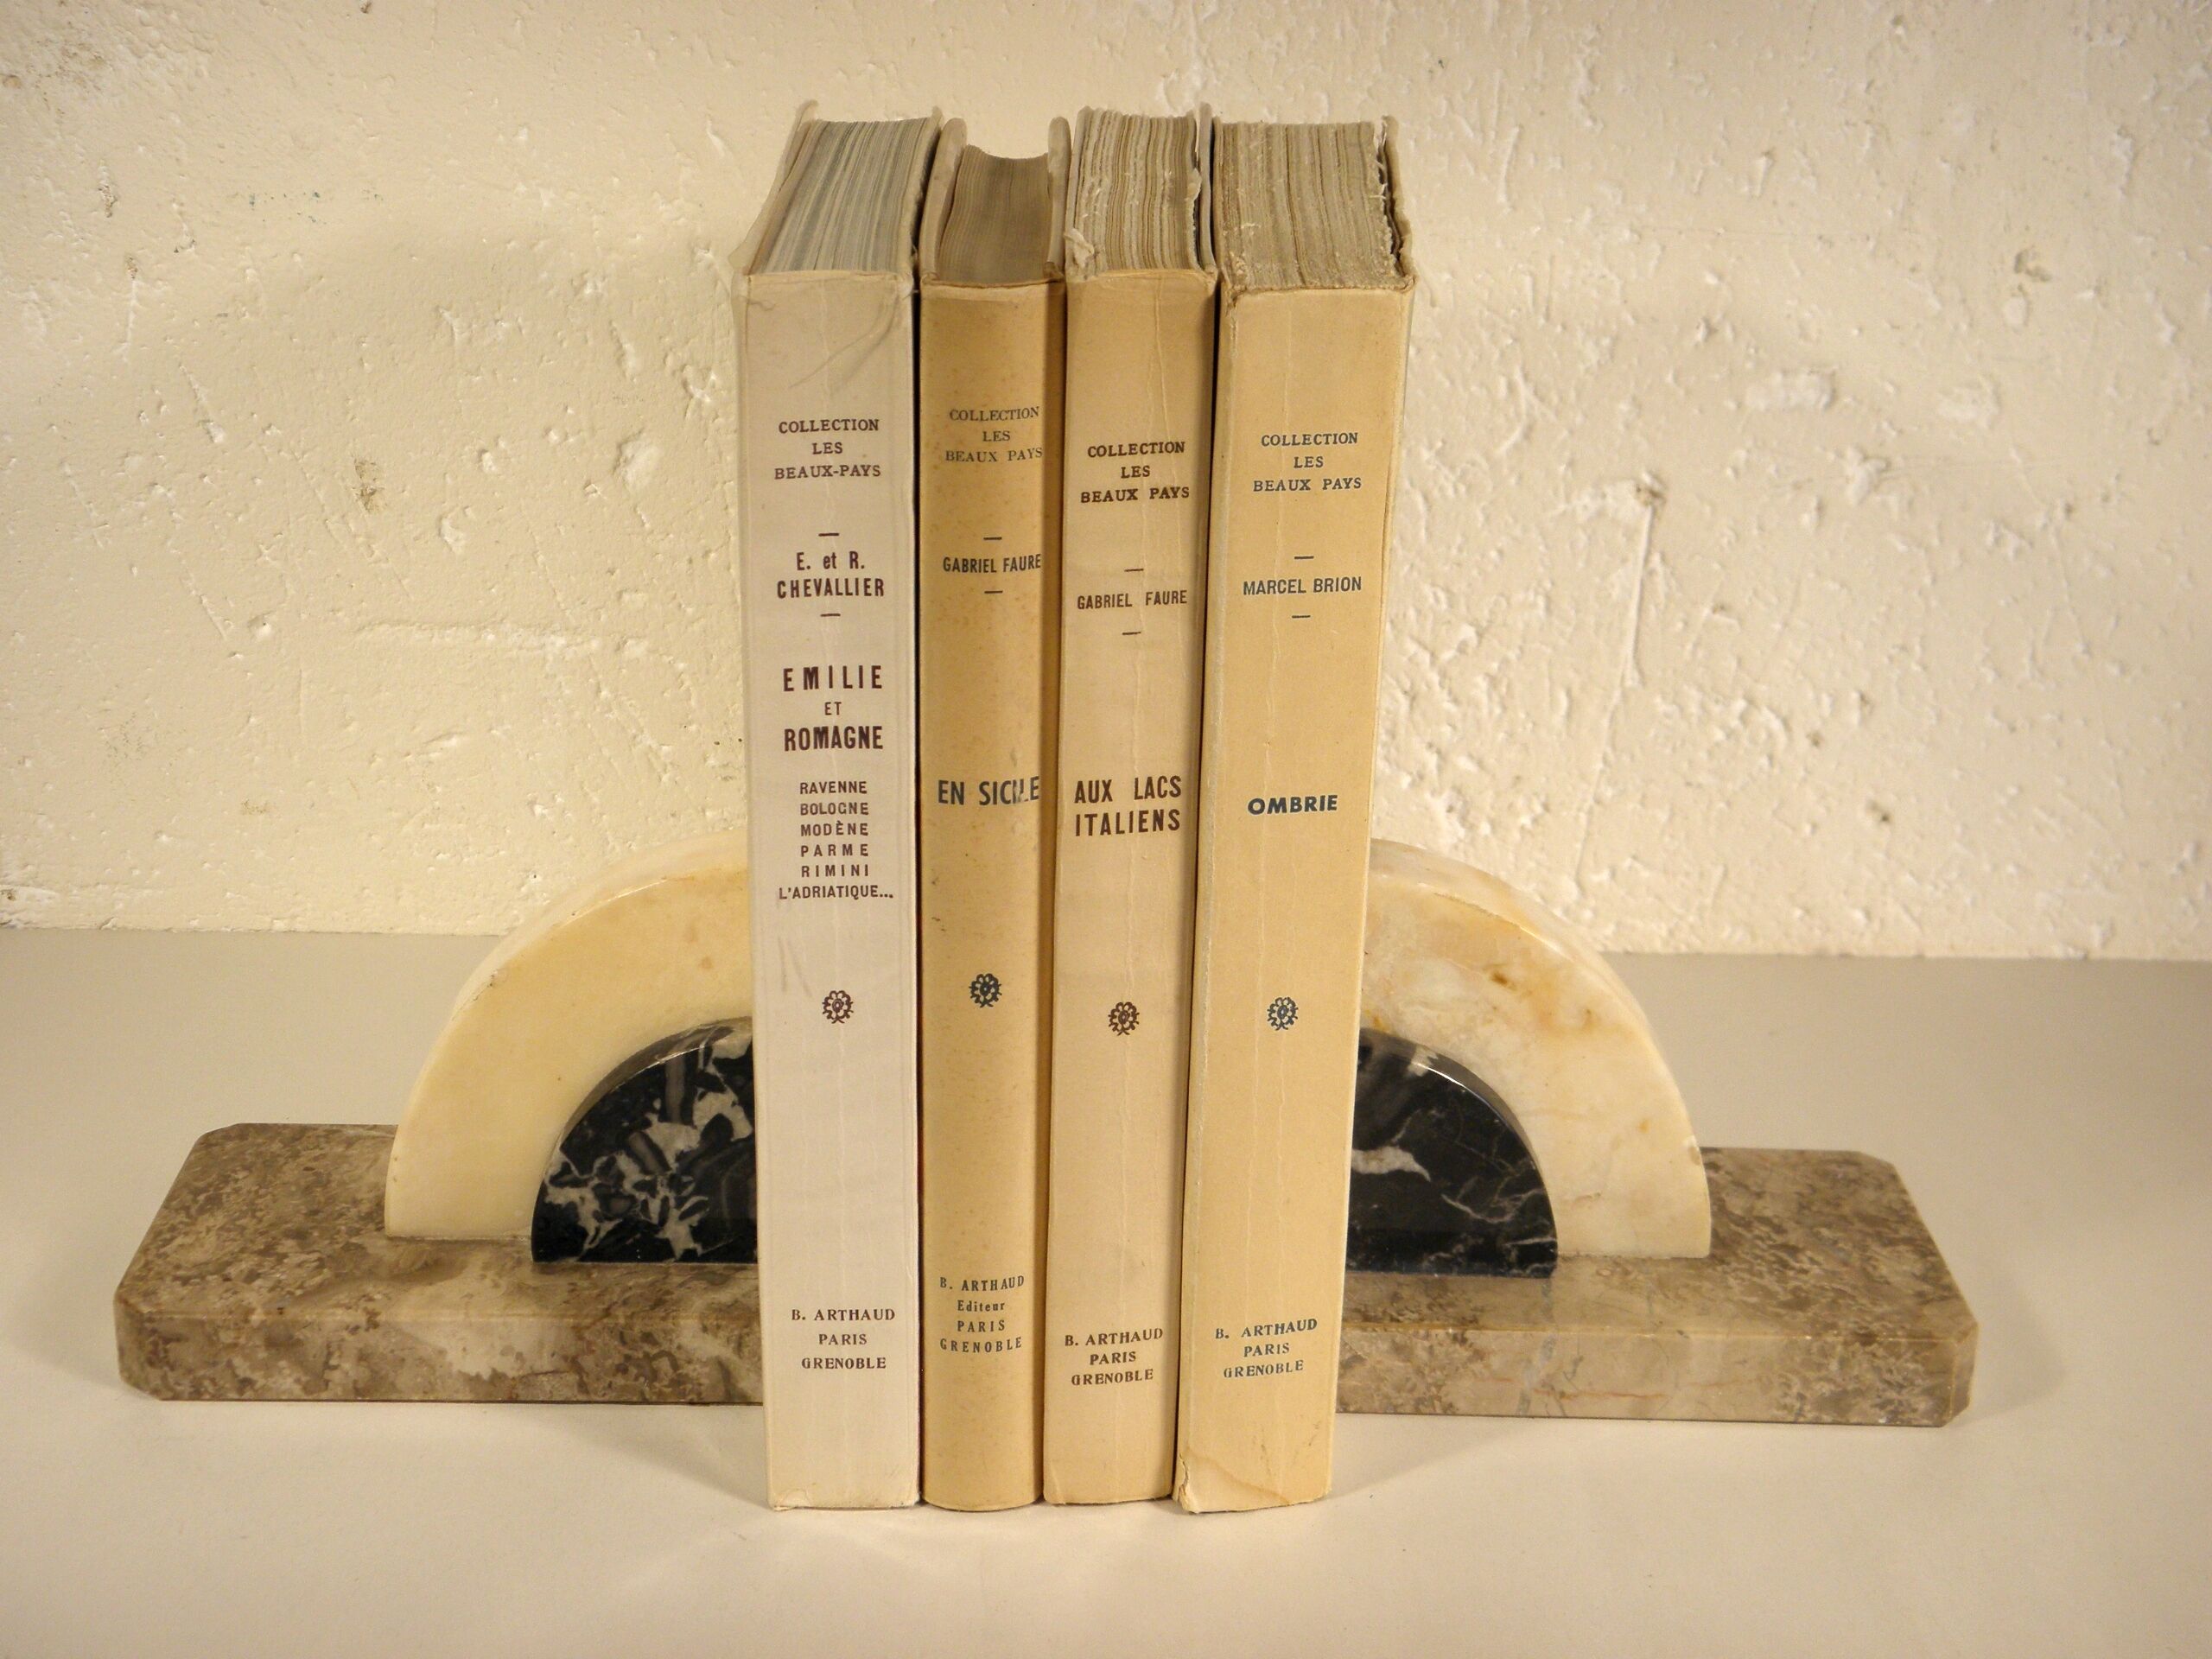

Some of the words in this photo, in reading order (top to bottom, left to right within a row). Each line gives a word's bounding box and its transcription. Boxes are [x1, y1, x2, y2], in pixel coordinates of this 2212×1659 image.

[950, 406, 1039, 422] COLLECTION
[779, 419, 880, 434] COLLECTION
[982, 430, 1010, 442] LES
[1262, 432, 1357, 447] COLLECTION
[812, 442, 842, 454] LES
[945, 450, 997, 462] BEAUX
[1007, 448, 1043, 461] PAYS
[1088, 442, 1185, 458] COLLECTION
[1294, 456, 1324, 468] LES
[774, 465, 880, 480] BEAUX-PAYS
[1121, 466, 1151, 479] LES
[1253, 479, 1311, 492] BEAUX
[1322, 478, 1361, 490] PAYS
[1081, 489, 1138, 503] BEAUX
[1149, 486, 1190, 499] PAYS
[797, 552, 810, 571] E.
[823, 552, 836, 569] et
[849, 551, 865, 569] R.
[944, 556, 996, 573] GABRIEL
[1003, 554, 1041, 572] FAURE
[778, 578, 884, 598] CHEVALLIER
[1243, 579, 1306, 595] MARCEL
[1313, 576, 1361, 593] BRION
[1077, 594, 1133, 609] GABRIEL
[1146, 590, 1187, 606] FAURE
[784, 665, 882, 691] EMILIE
[824, 702, 842, 715] ET
[785, 726, 883, 751] ROMAGNE
[800, 781, 868, 794] RAVENNE
[938, 779, 964, 805] EN
[1075, 779, 1113, 804] AUX
[1134, 776, 1181, 800] LACS
[800, 802, 868, 815] BOLOGNE
[1248, 795, 1338, 815] OMBRIE
[801, 820, 868, 836] MODÈNE
[1075, 809, 1180, 836] ITALIENS
[801, 844, 868, 857] PARME
[802, 865, 868, 877] RIMINI
[940, 1277, 953, 1289] B.
[962, 1275, 1024, 1291] ARTHAUD
[957, 1300, 1005, 1312] Editeur
[791, 1309, 806, 1320] B.
[814, 1309, 895, 1321] ARTHAUD
[957, 1320, 1005, 1332] PARIS
[1215, 1328, 1230, 1339] B.
[1241, 1319, 1318, 1338] ARTHAUD
[819, 1334, 868, 1345] PARIS
[1065, 1335, 1078, 1346] B.
[1085, 1328, 1163, 1345] ARTHAUD
[940, 1337, 1021, 1353] GRENOBLE
[1243, 1343, 1290, 1357] PARIS
[802, 1357, 886, 1369] GRENOBLE
[1090, 1351, 1136, 1365] PARIS
[1224, 1360, 1304, 1378] GRENOBLE
[1071, 1369, 1154, 1385] GRENOBLE
